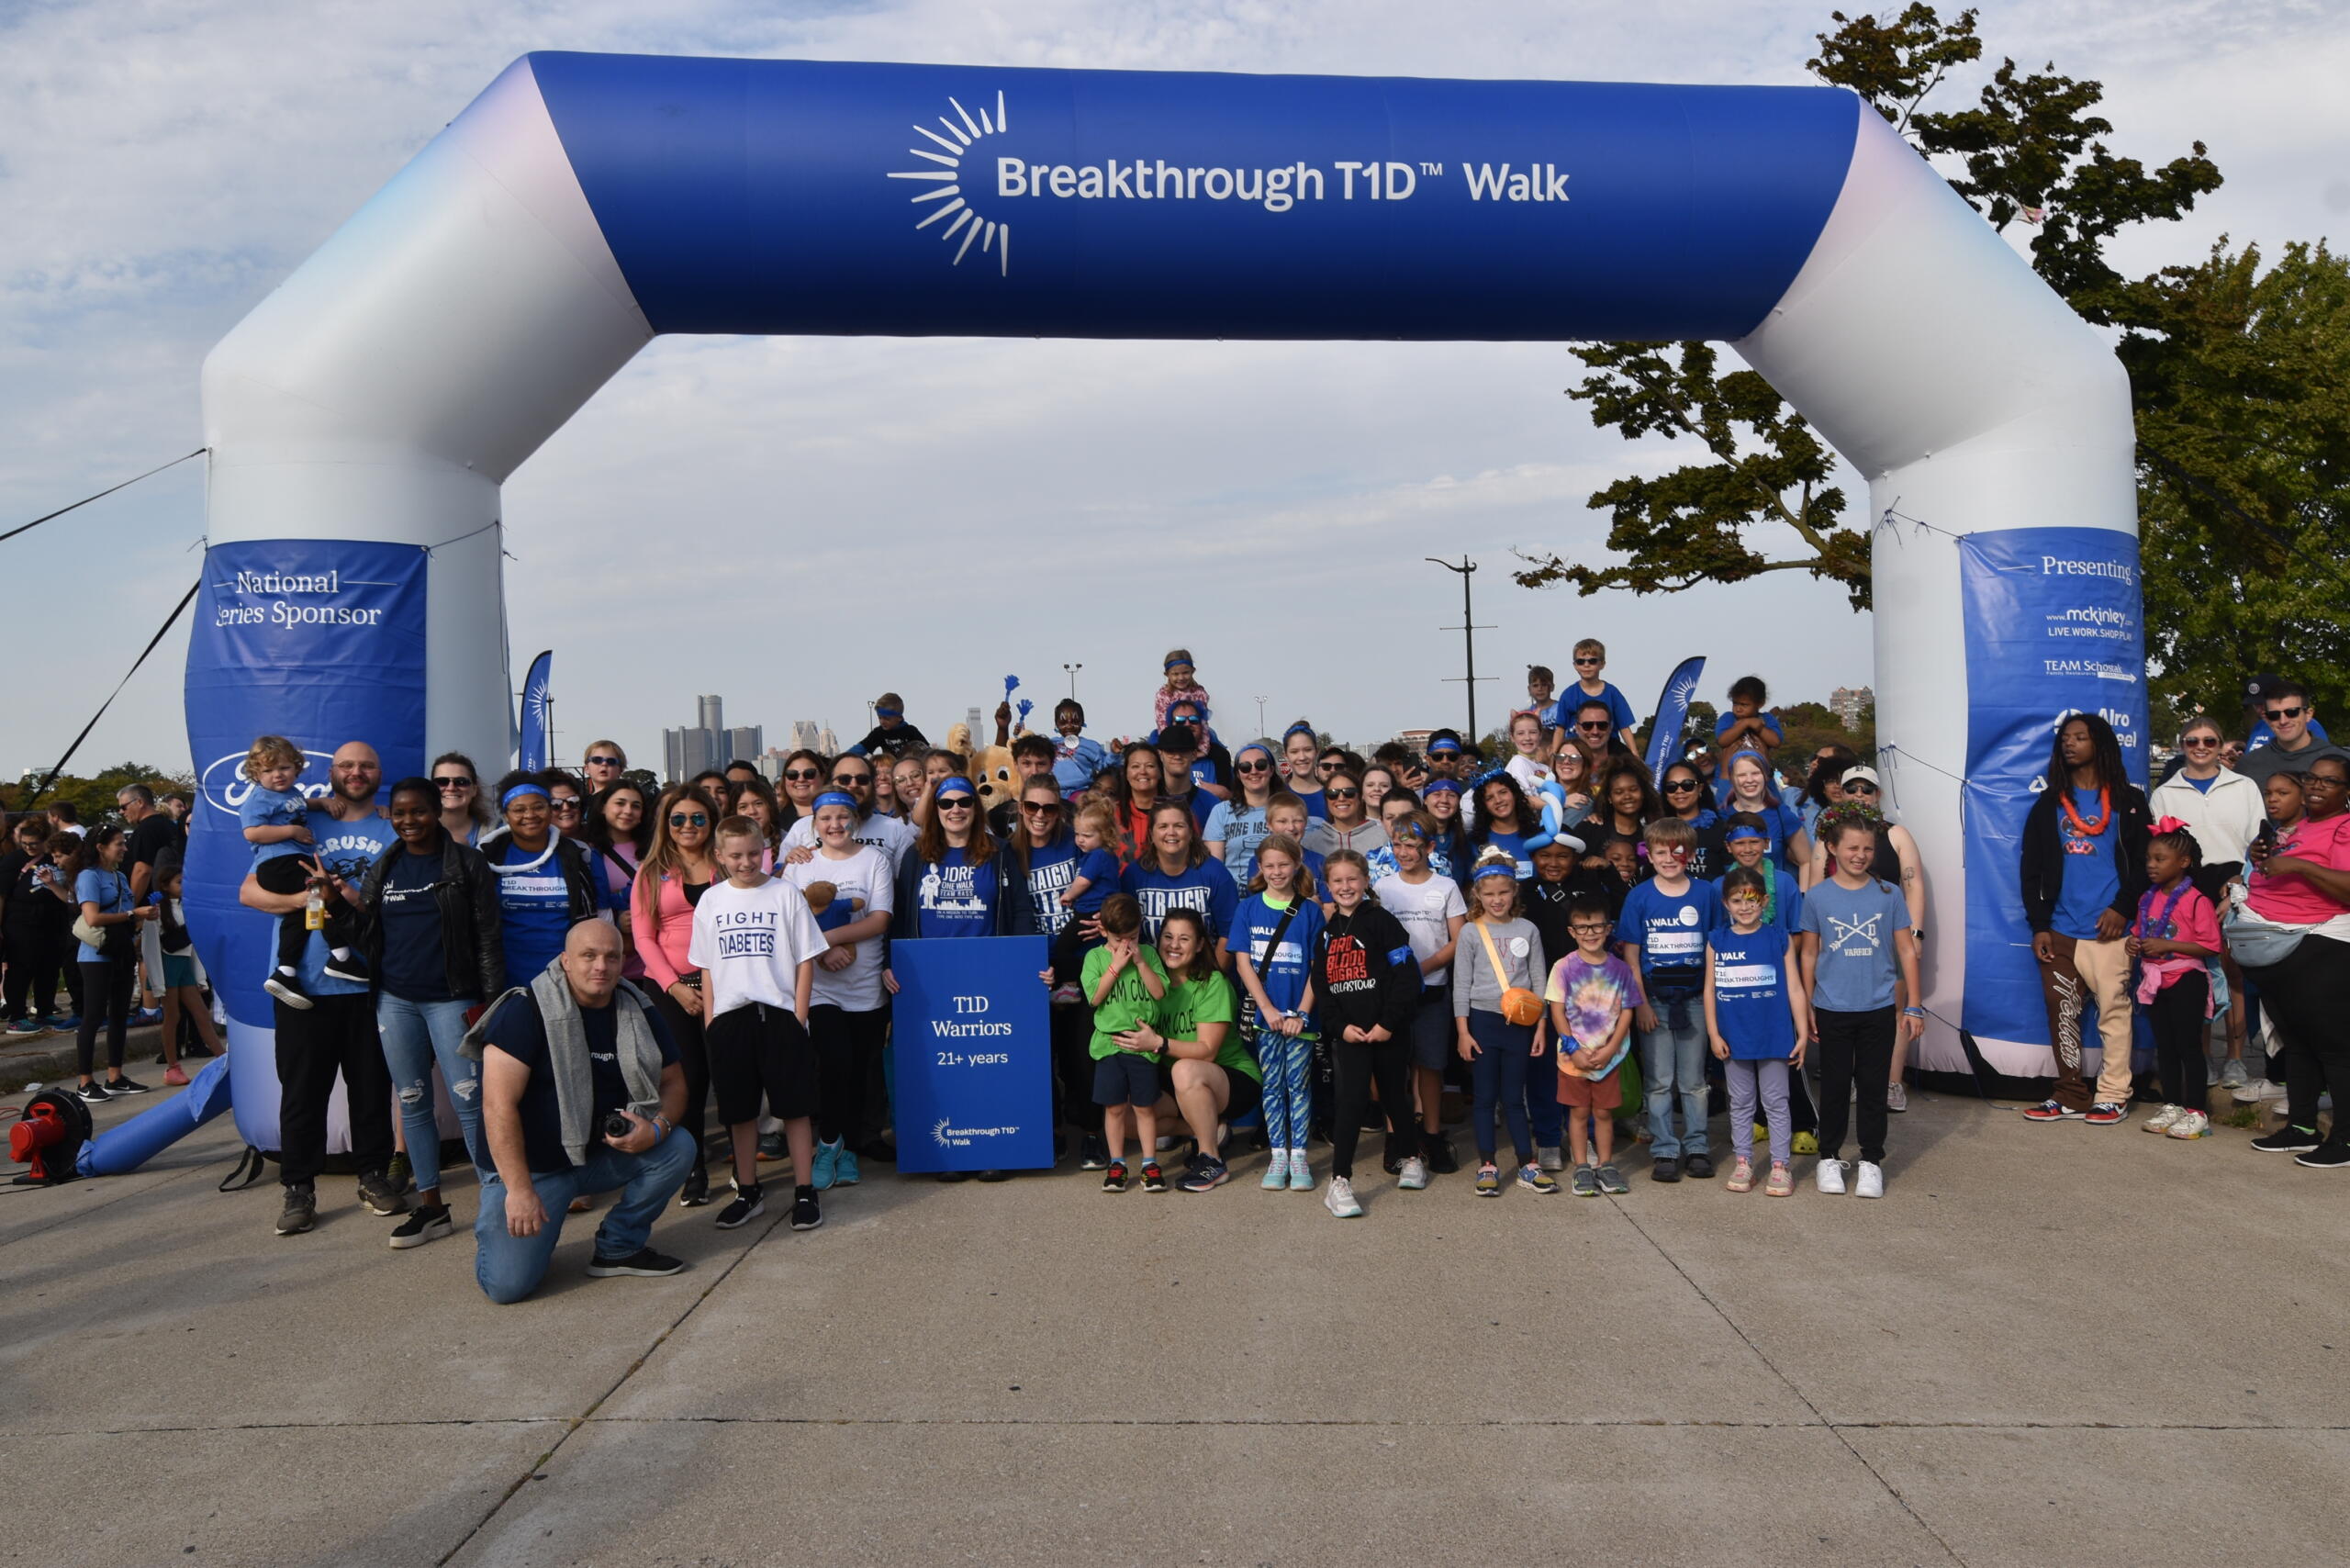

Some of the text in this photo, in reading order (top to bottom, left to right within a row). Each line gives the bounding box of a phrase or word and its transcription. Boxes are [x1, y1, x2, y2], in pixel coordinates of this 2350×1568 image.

[997, 156, 1324, 212] Breakthrough
[1463, 162, 1571, 203] Walk
[2042, 555, 2132, 586] Presenting
[235, 570, 340, 594] National
[271, 600, 382, 630] Sponsor
[2044, 660, 2081, 671] TEAM
[316, 834, 382, 857] CRUSH
[943, 867, 976, 882] JDRF
[716, 912, 778, 927] FIGHT
[1651, 918, 1681, 926] WALK
[719, 933, 775, 955] DIABETES
[1326, 949, 1366, 970] BLOOD
[1327, 966, 1368, 983] SUGARS
[953, 995, 989, 1014] T1D
[931, 1020, 1013, 1037] Warriors
[937, 1052, 1009, 1068] 21+ years
[946, 1127, 1000, 1137] Breakthrough
[952, 1138, 971, 1147] Walk
